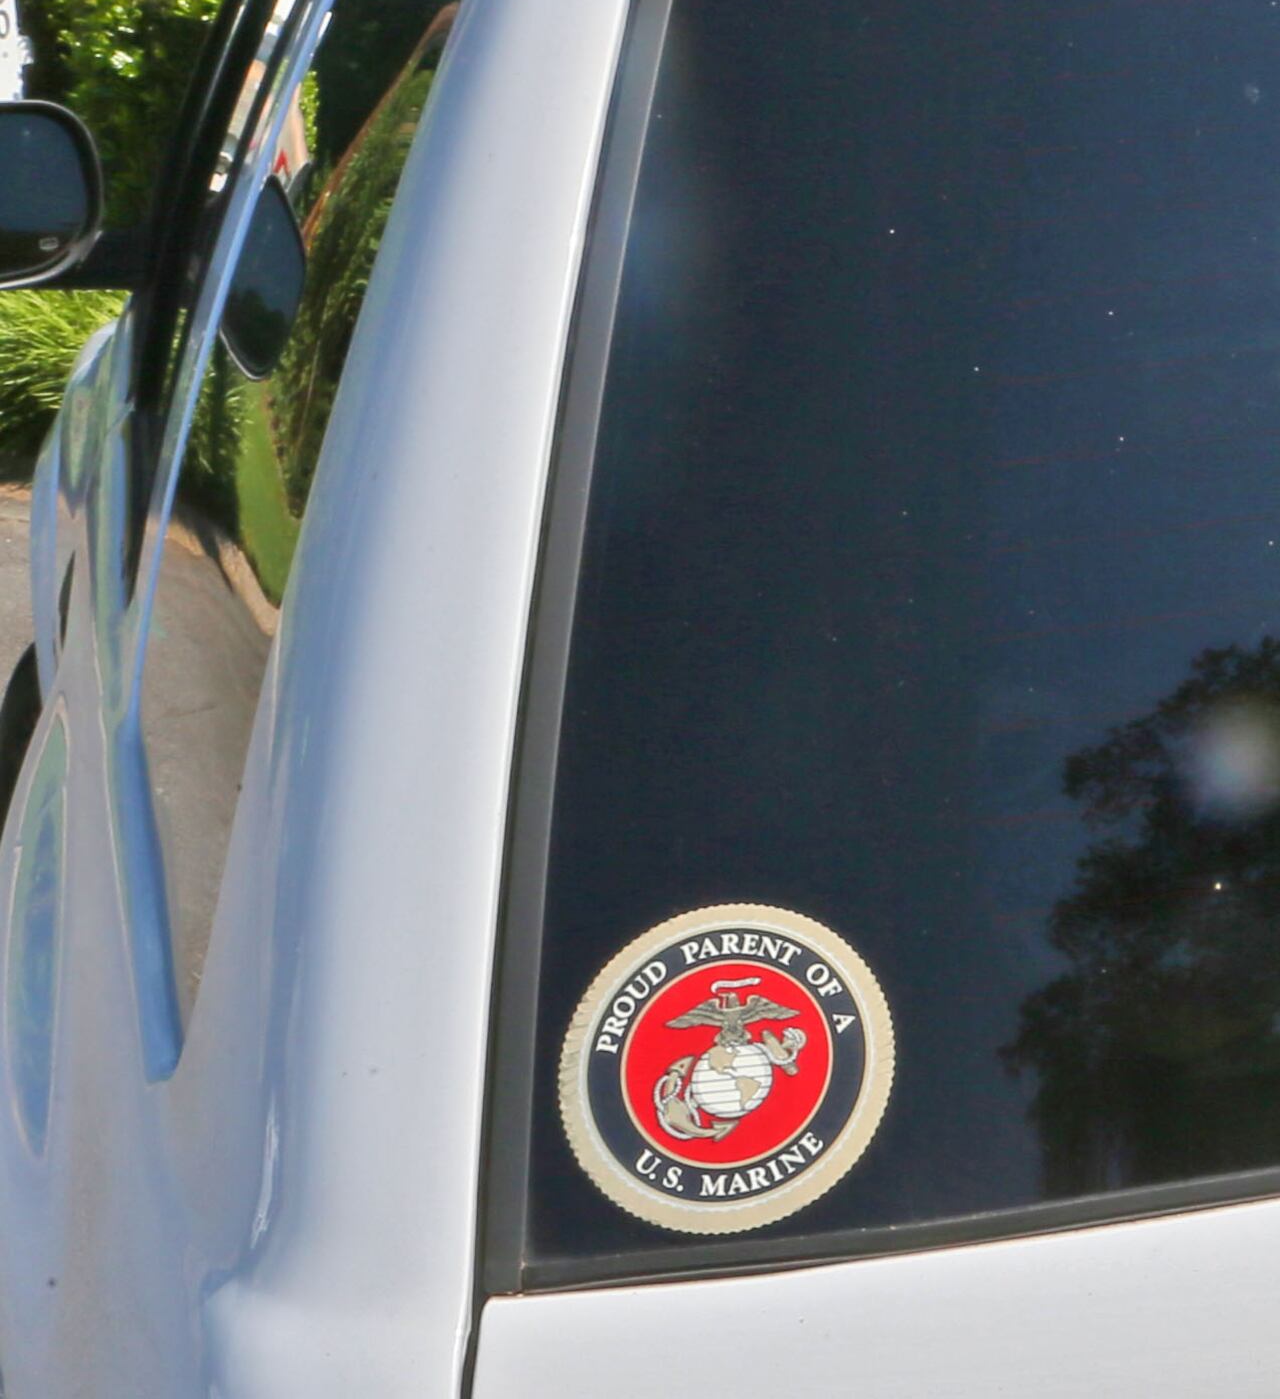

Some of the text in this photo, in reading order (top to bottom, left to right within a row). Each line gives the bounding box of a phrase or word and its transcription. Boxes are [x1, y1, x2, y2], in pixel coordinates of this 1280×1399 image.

[597, 933, 856, 1054] PROUD PARENT OF A
[635, 1132, 823, 1197] U.S. MARINE
